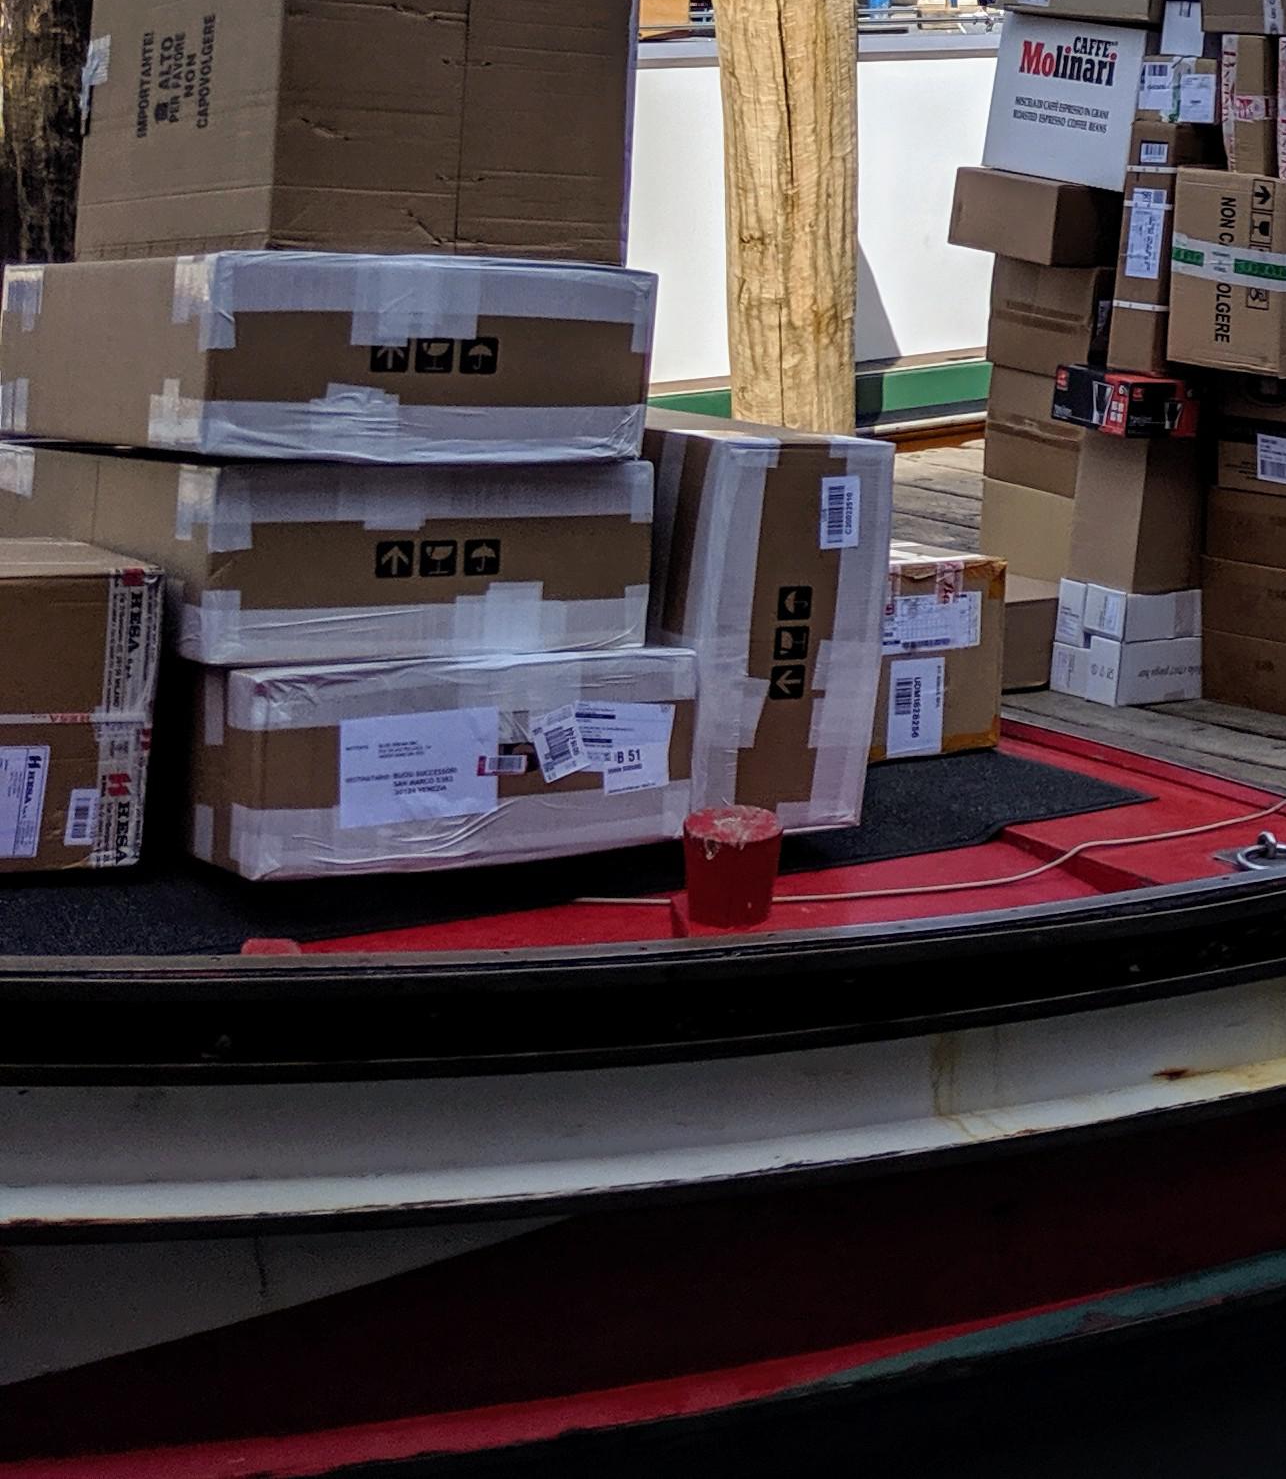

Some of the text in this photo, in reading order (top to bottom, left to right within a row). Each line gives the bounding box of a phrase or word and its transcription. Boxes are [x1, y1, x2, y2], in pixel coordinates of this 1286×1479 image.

[136, 31, 154, 139] IMPORTANTE!
[158, 36, 175, 90] ALTO
[168, 32, 187, 124] PER FAVORE
[183, 53, 198, 99] NON
[195, 13, 217, 130] CAPOVOLGERE
[1018, 39, 1118, 87] Molinari
[1219, 196, 1237, 229] NON
[127, 592, 143, 654] HESA
[627, 748, 642, 763] 51
[417, 785, 448, 794] VENEZIA
[114, 801, 131, 865] HESA
